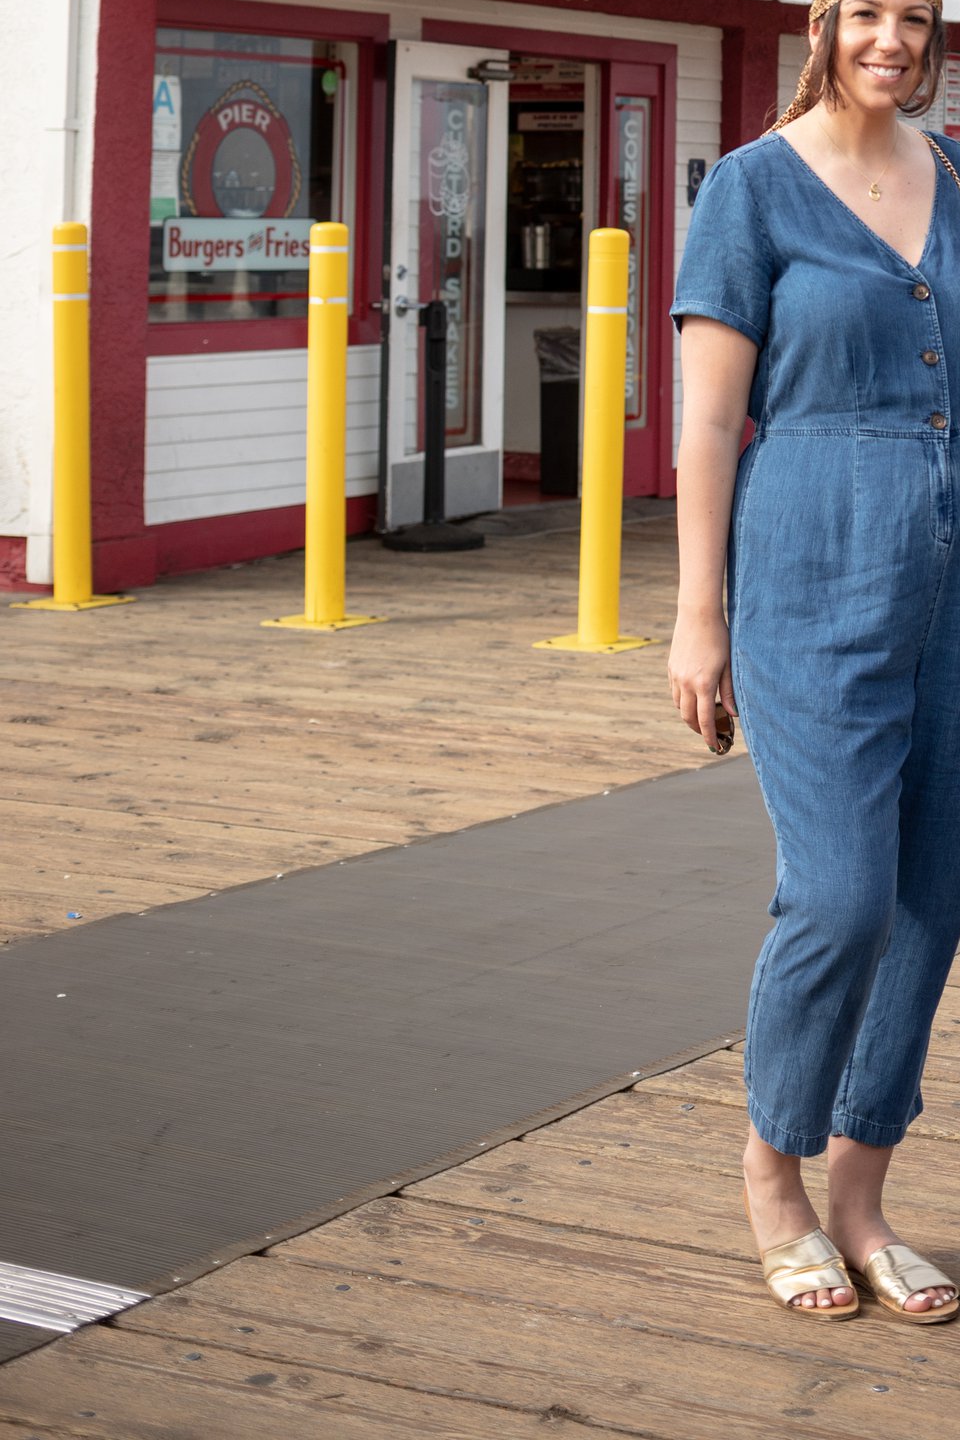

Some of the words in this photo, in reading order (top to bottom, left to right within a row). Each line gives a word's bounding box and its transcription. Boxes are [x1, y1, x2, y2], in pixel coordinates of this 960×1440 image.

[153, 80, 175, 114] A
[217, 104, 271, 131] PIER
[623, 120, 639, 223] CONES
[168, 227, 244, 266] Burgers
[265, 227, 310, 257] Fries
[445, 277, 461, 410] SHAKES
